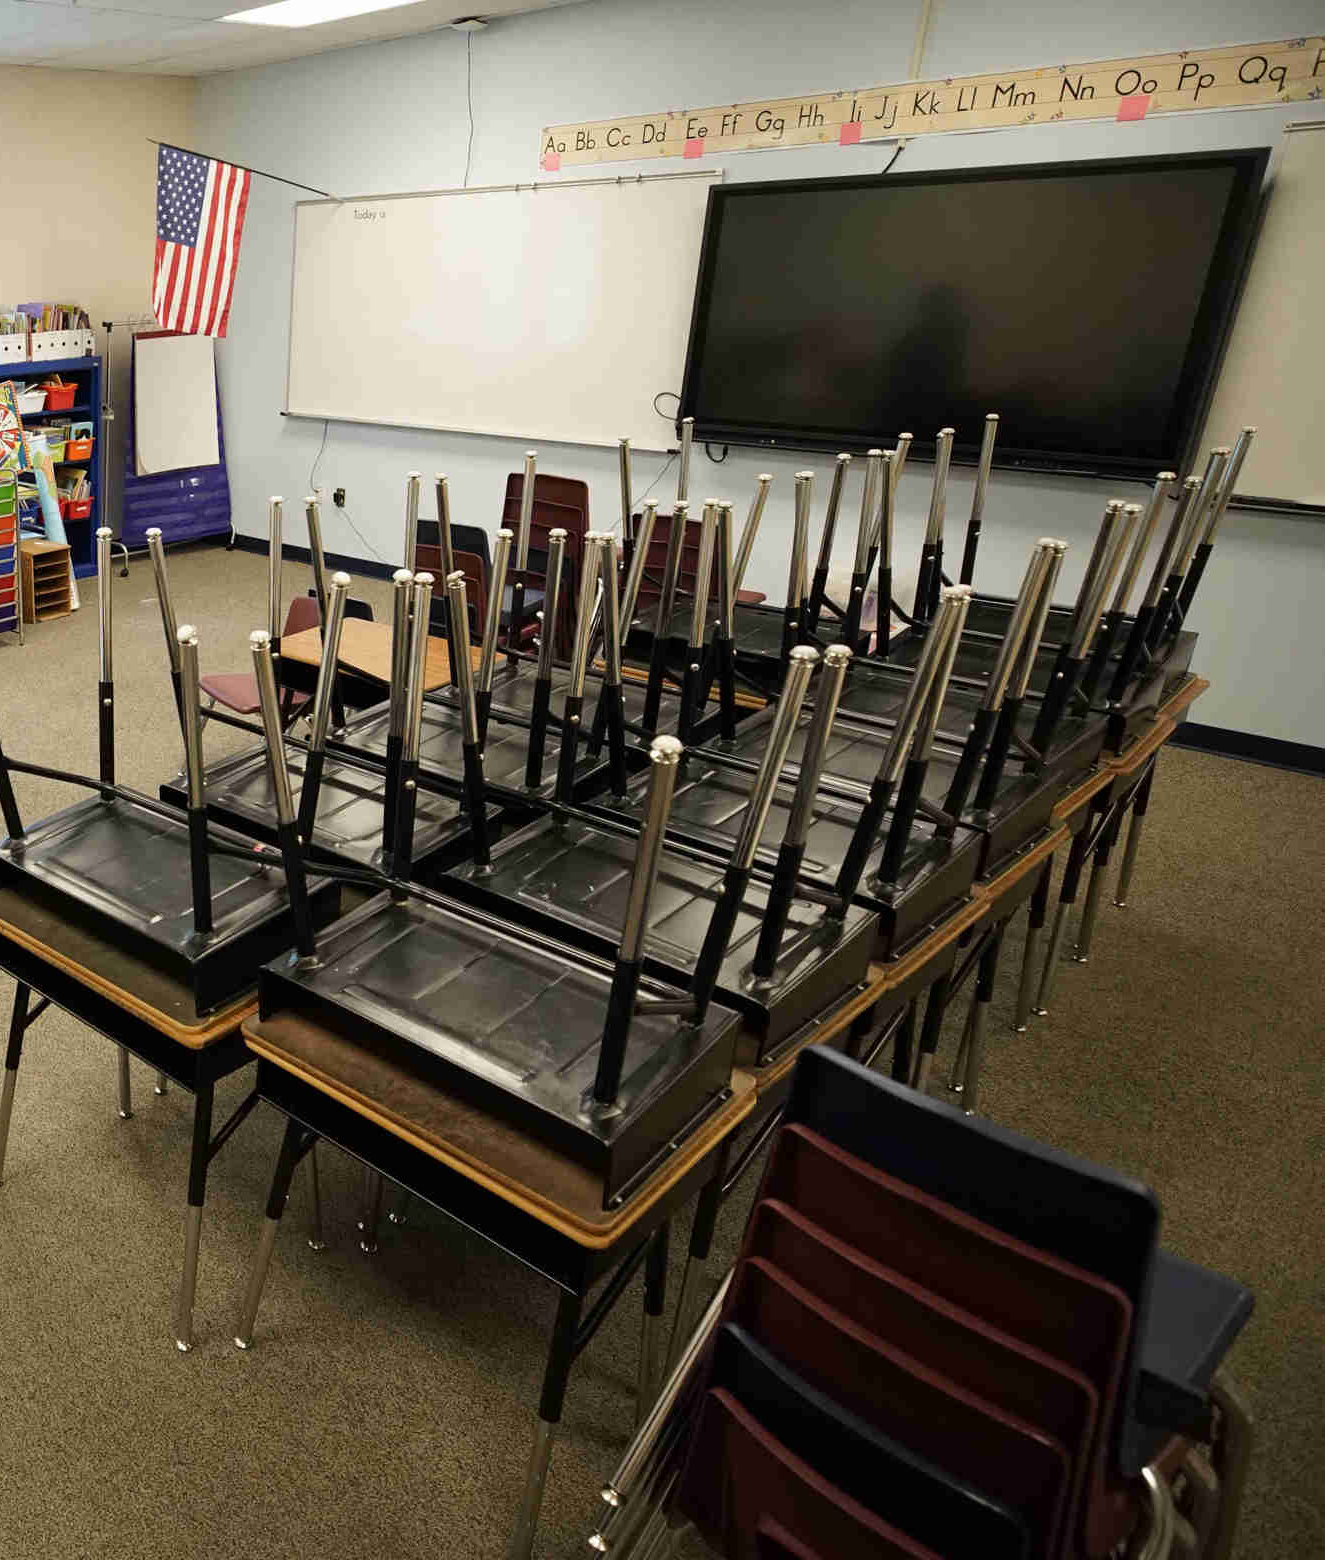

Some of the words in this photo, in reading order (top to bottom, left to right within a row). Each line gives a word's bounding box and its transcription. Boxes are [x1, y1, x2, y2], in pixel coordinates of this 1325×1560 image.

[545, 135, 566, 153] Aa
[575, 132, 596, 151] Bb
[606, 128, 631, 148] Cc
[642, 122, 666, 144] Dd
[686, 118, 708, 139] Ee
[720, 114, 741, 137] Ff
[755, 110, 785, 139] Gg
[798, 104, 824, 128] Hh
[850, 100, 862, 123] Ii
[874, 96, 898, 128] Jj
[911, 92, 939, 116] Kk
[957, 86, 978, 112] Ll
[992, 82, 1036, 108] Mm
[1059, 75, 1094, 102] Nn
[1115, 70, 1158, 96] Oo
[1177, 63, 1215, 101] Pp
[1239, 56, 1287, 91] Qq
